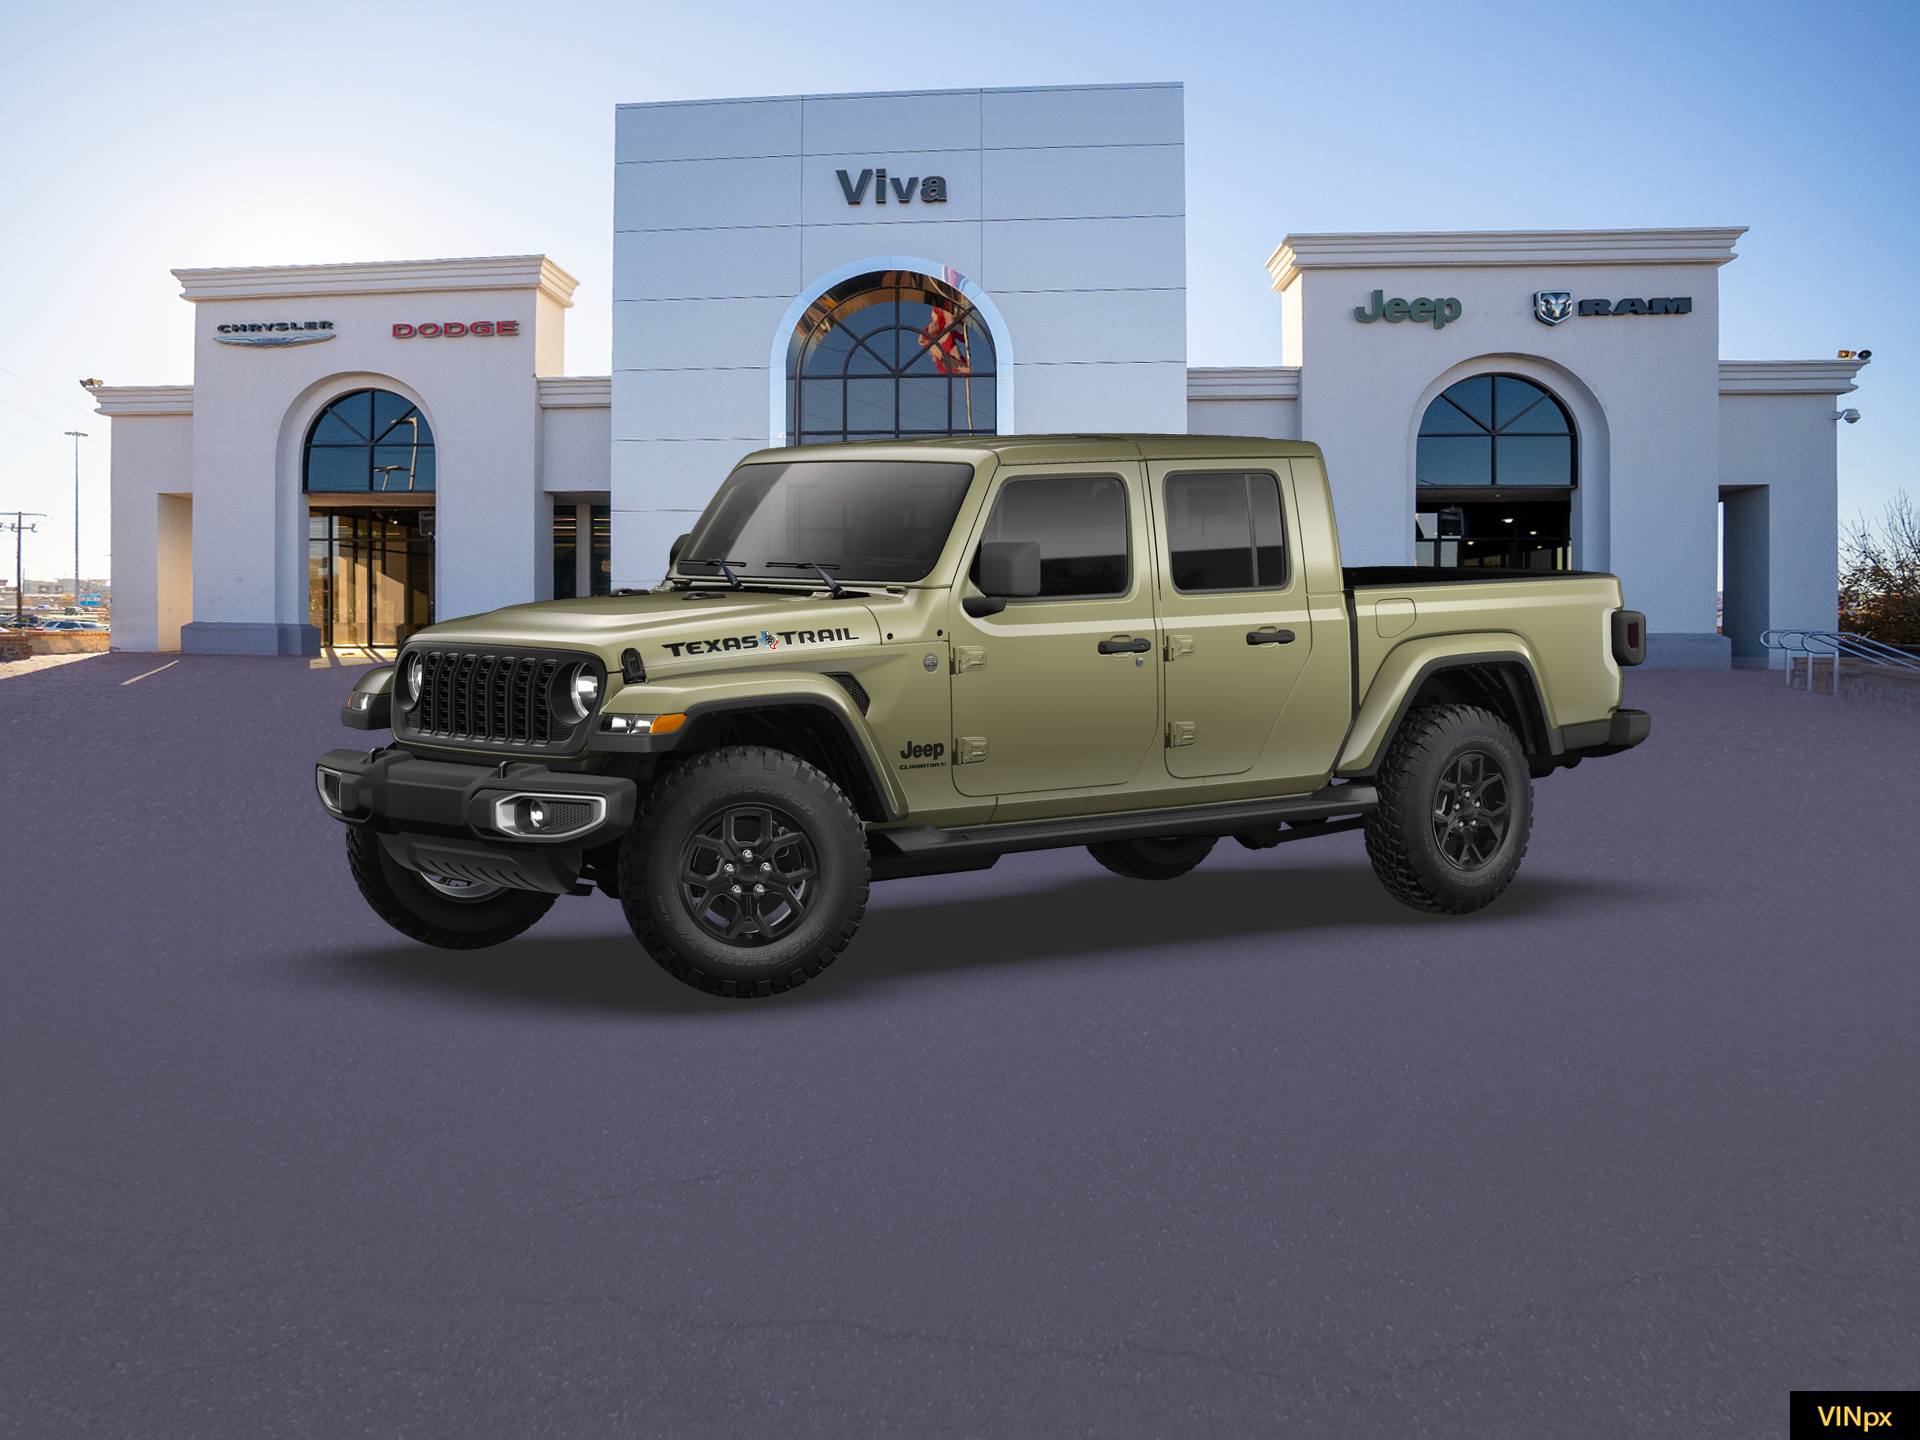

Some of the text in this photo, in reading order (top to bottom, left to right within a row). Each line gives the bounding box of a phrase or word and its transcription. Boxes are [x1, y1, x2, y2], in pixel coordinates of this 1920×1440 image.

[835, 168, 947, 205] Viva
[1354, 289, 1462, 329] Jeep
[1578, 297, 1692, 316] RAM
[217, 320, 333, 334] CHRYSLER
[392, 320, 519, 338] DODGE
[661, 627, 860, 657] TEXAS TRAIL
[900, 740, 945, 760] Jeep
[899, 762, 940, 770] GLADIATOR
[688, 784, 815, 818] BFGoodrich
